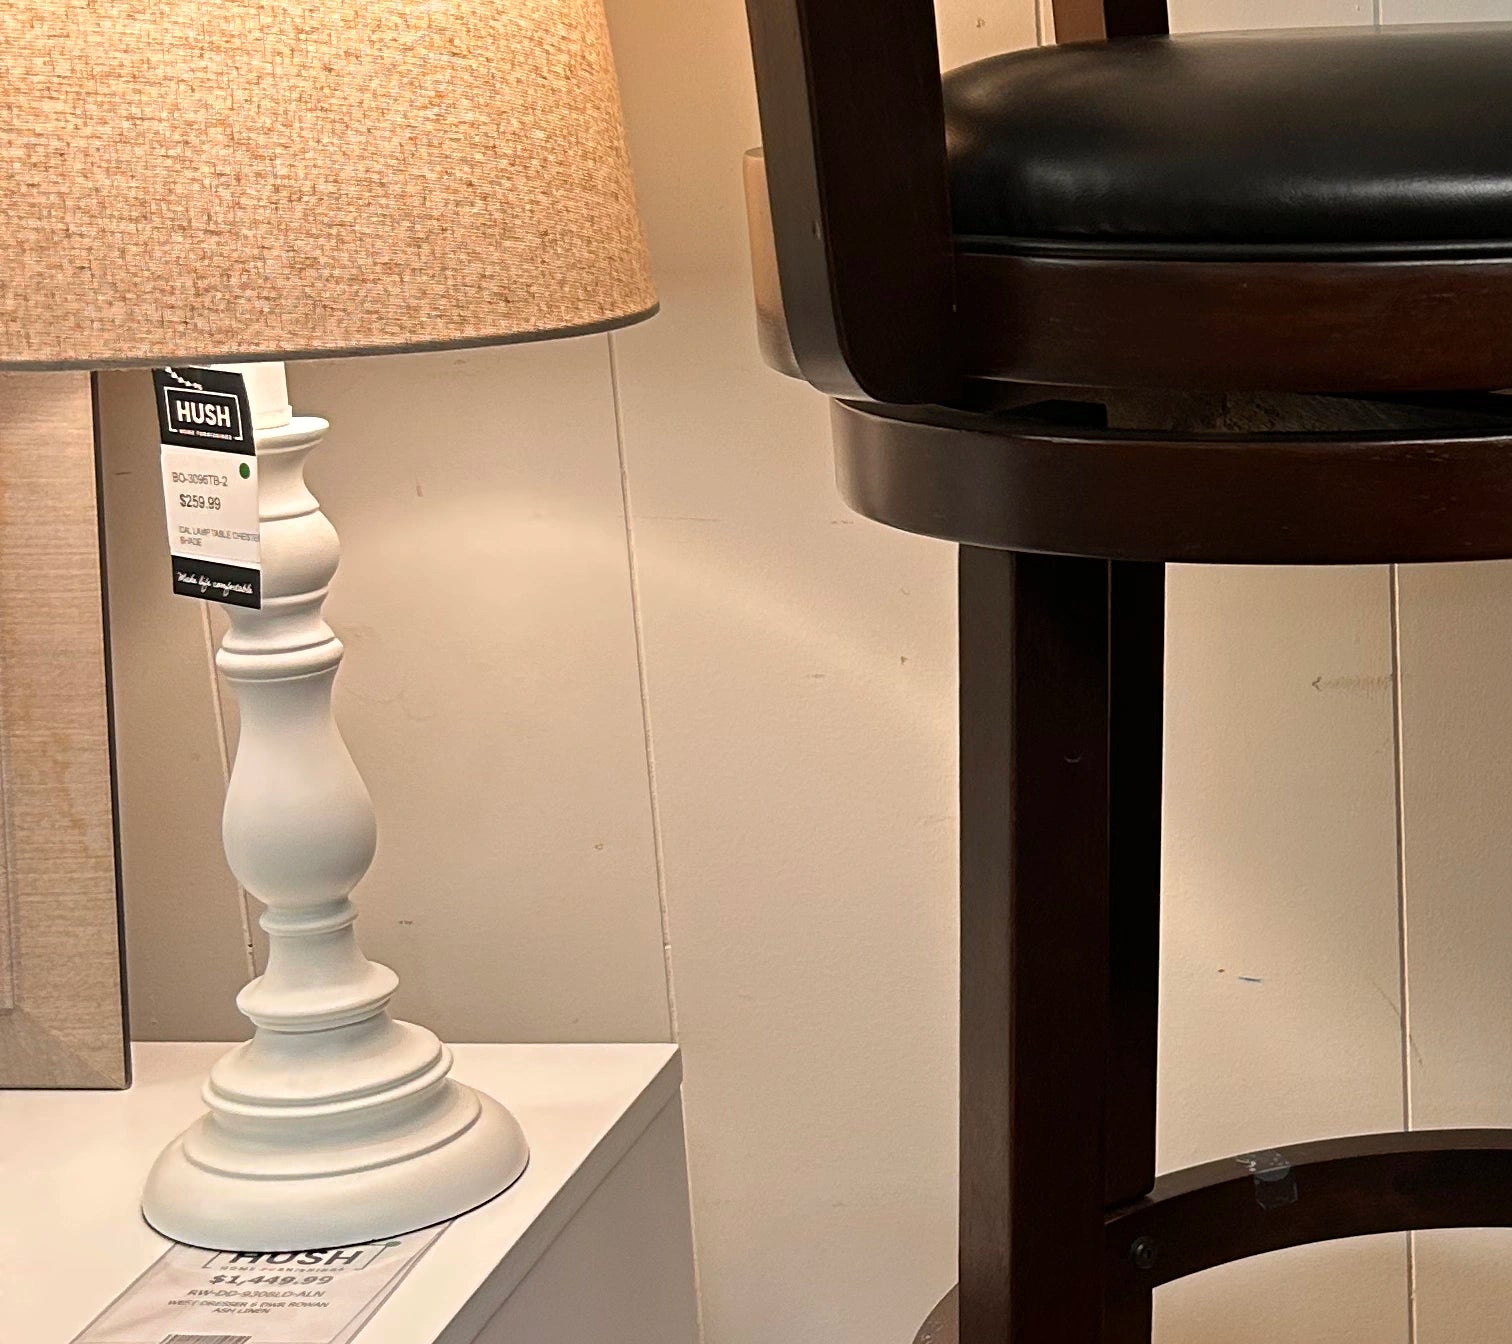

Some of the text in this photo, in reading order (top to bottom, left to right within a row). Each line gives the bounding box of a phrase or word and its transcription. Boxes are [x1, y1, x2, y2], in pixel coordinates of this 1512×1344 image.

[176, 400, 231, 428] HUSH
[179, 493, 221, 510] $259.99
[209, 1274, 335, 1286] $1,449.99
